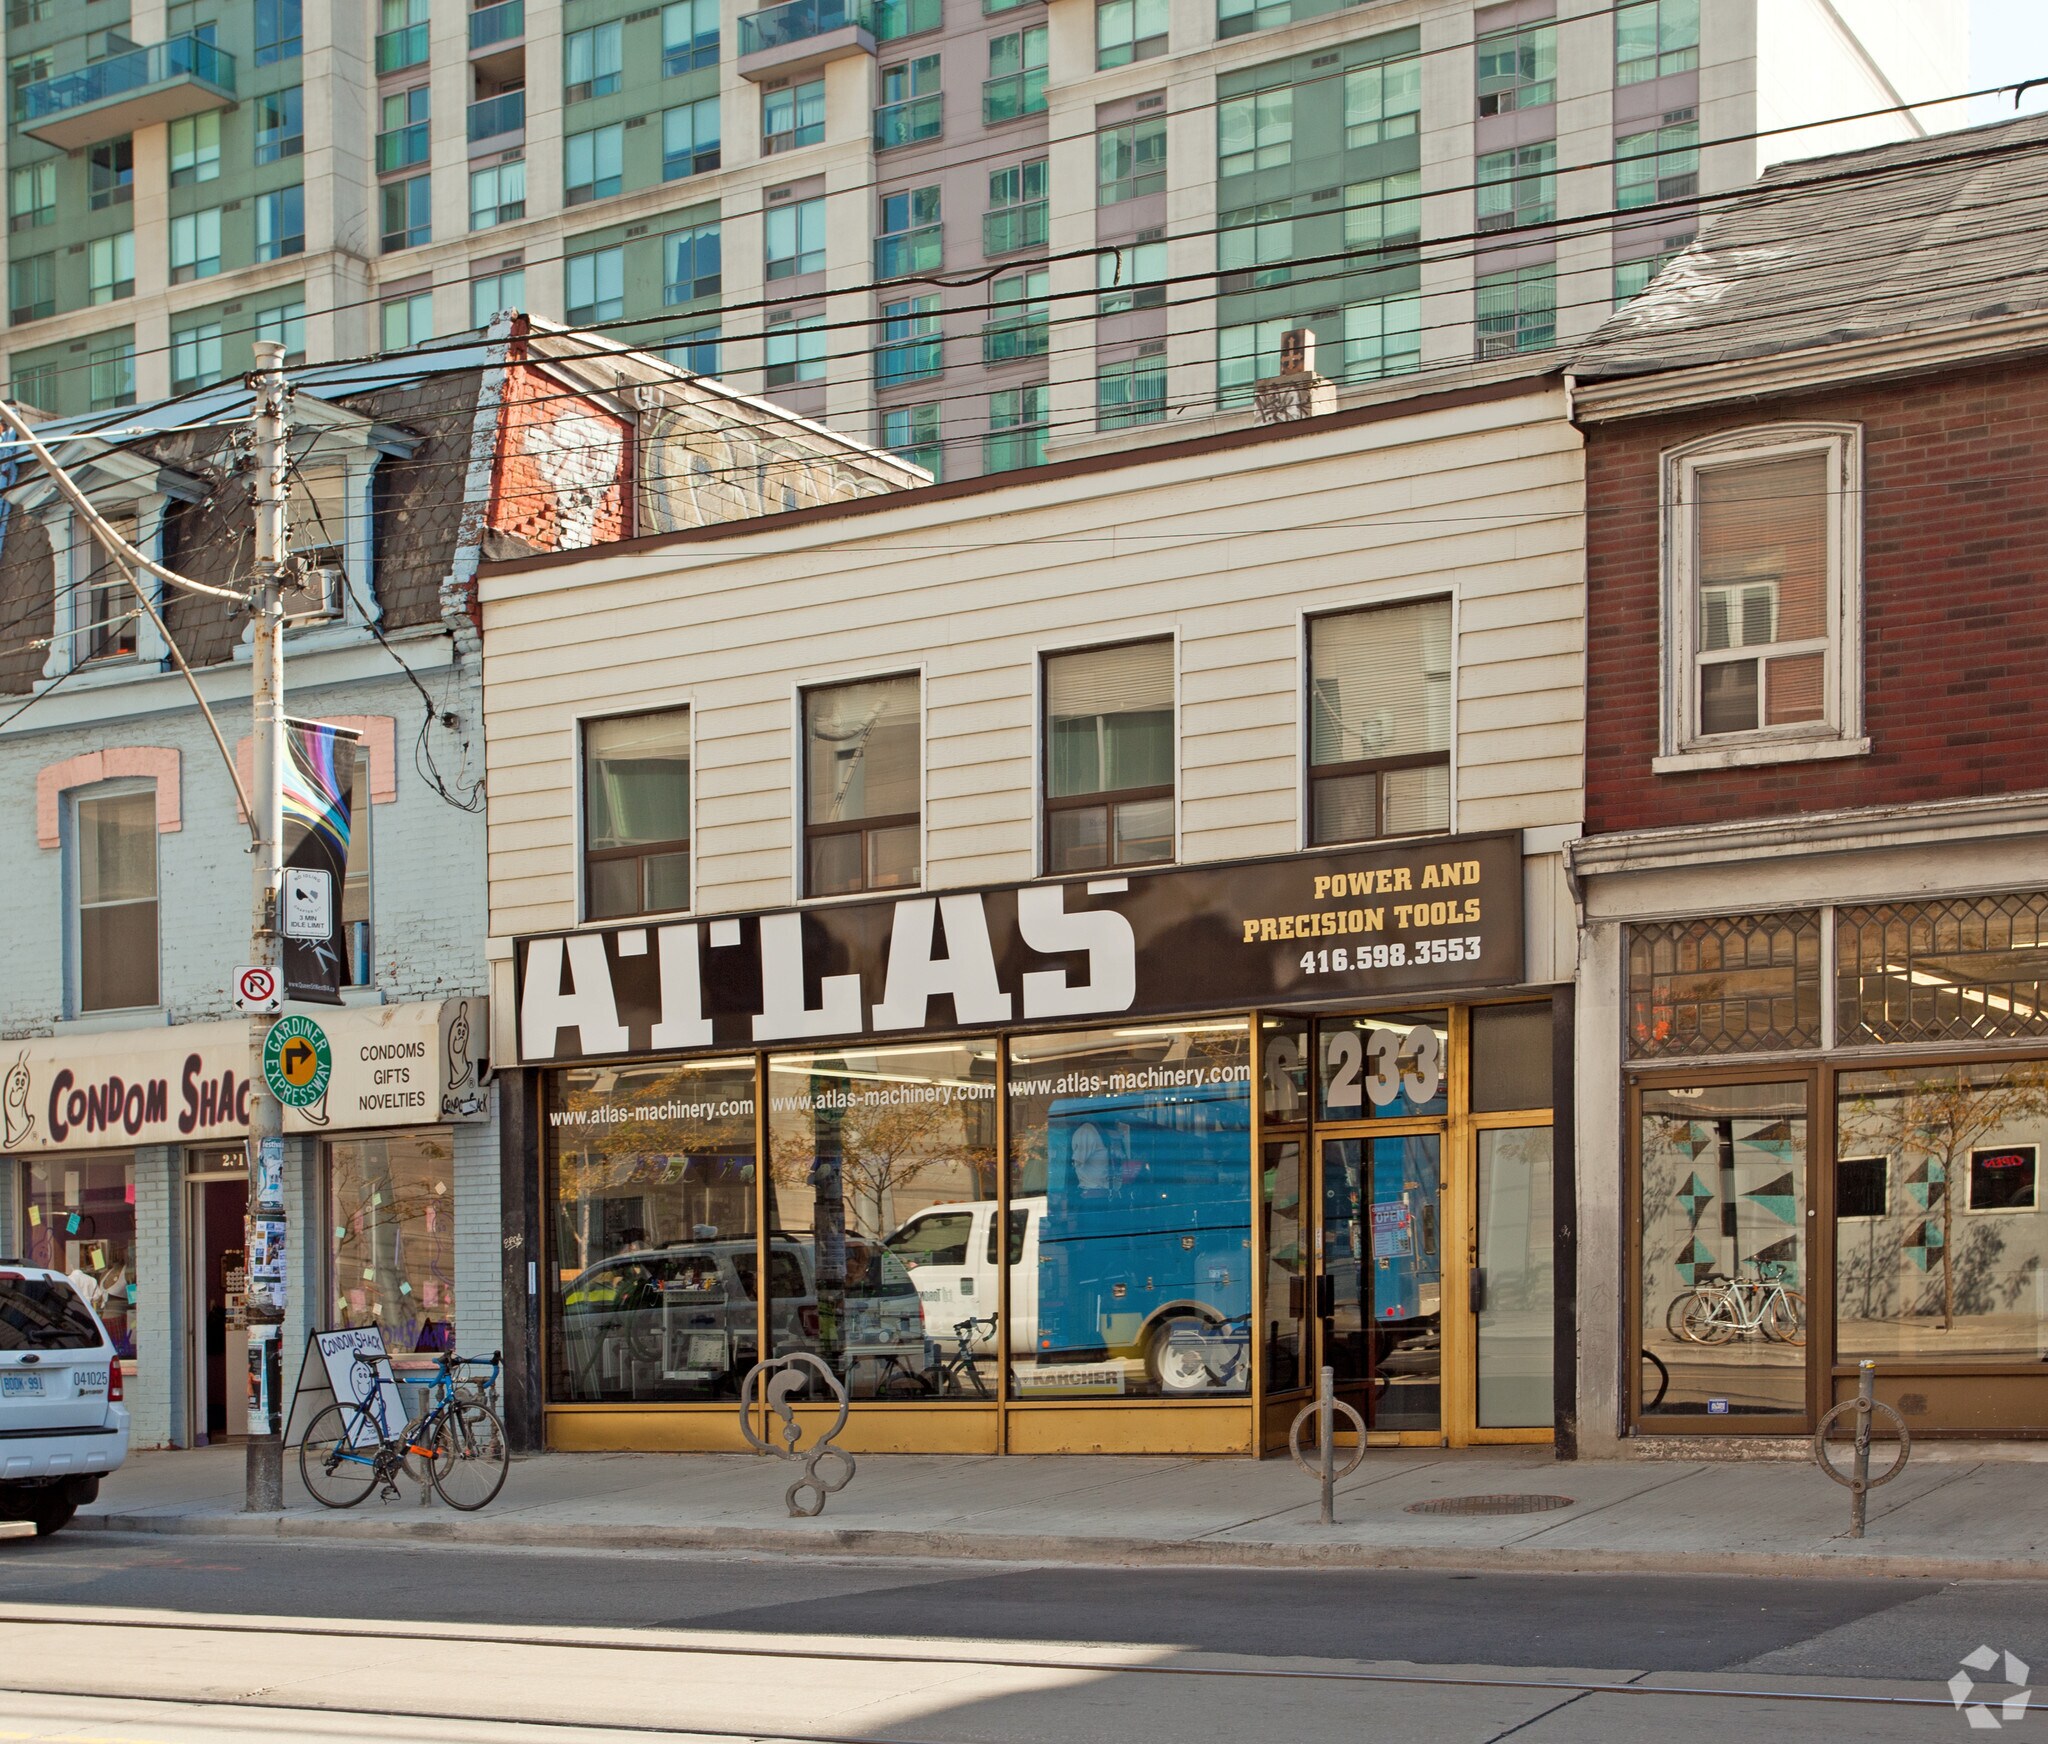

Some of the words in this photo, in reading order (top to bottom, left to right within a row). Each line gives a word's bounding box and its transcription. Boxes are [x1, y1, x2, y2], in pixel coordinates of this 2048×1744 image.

[1314, 868, 1412, 899] POWER
[1421, 861, 1480, 889] AND
[1243, 907, 1385, 943] PRECISION
[1394, 899, 1480, 929] TOOLS
[521, 878, 1135, 1060] ATLAS
[1300, 936, 1481, 974] 416.598.3553
[268, 1018, 327, 1053] GARDINER
[360, 1042, 425, 1061] CONDOMS
[1327, 1024, 1439, 1108] 233
[265, 1059, 330, 1106] EXPRESSWAY
[374, 1067, 410, 1085] GIFTS
[1008, 1065, 1250, 1096] www.atlas-machinery.com
[48, 1068, 168, 1143] CONDOM
[178, 1053, 250, 1134] SHAC
[359, 1091, 425, 1111] NOVELTIES
[550, 1098, 754, 1127] www.atlas-machinery.com
[771, 1083, 995, 1113] www.atlas-machinery.com
[1375, 1210, 1405, 1223] OPEN
[321, 1334, 355, 1356] CONDOM
[355, 1332, 382, 1350] SHACK
[74, 1371, 107, 1386] 041025
